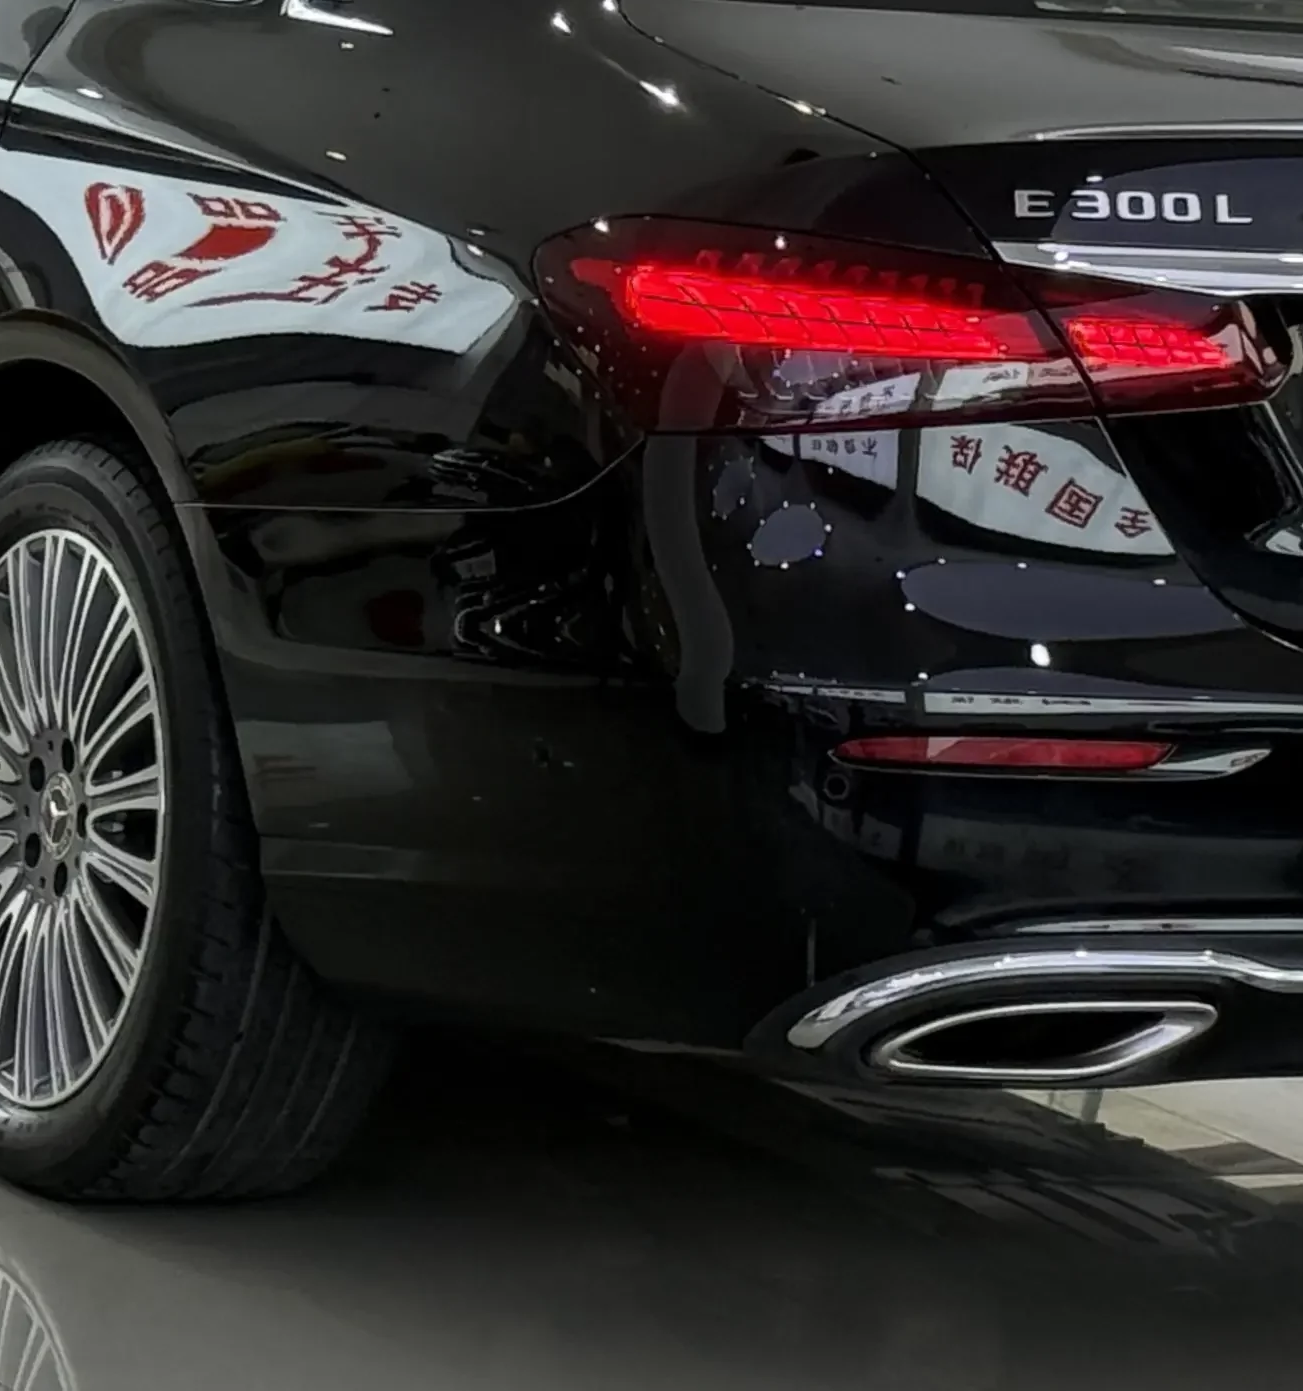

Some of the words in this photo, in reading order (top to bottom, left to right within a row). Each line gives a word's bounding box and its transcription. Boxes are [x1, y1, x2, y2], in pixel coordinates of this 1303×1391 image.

[1014, 190, 1055, 218] E
[1071, 190, 1202, 224] 300
[1215, 194, 1253, 223] L
